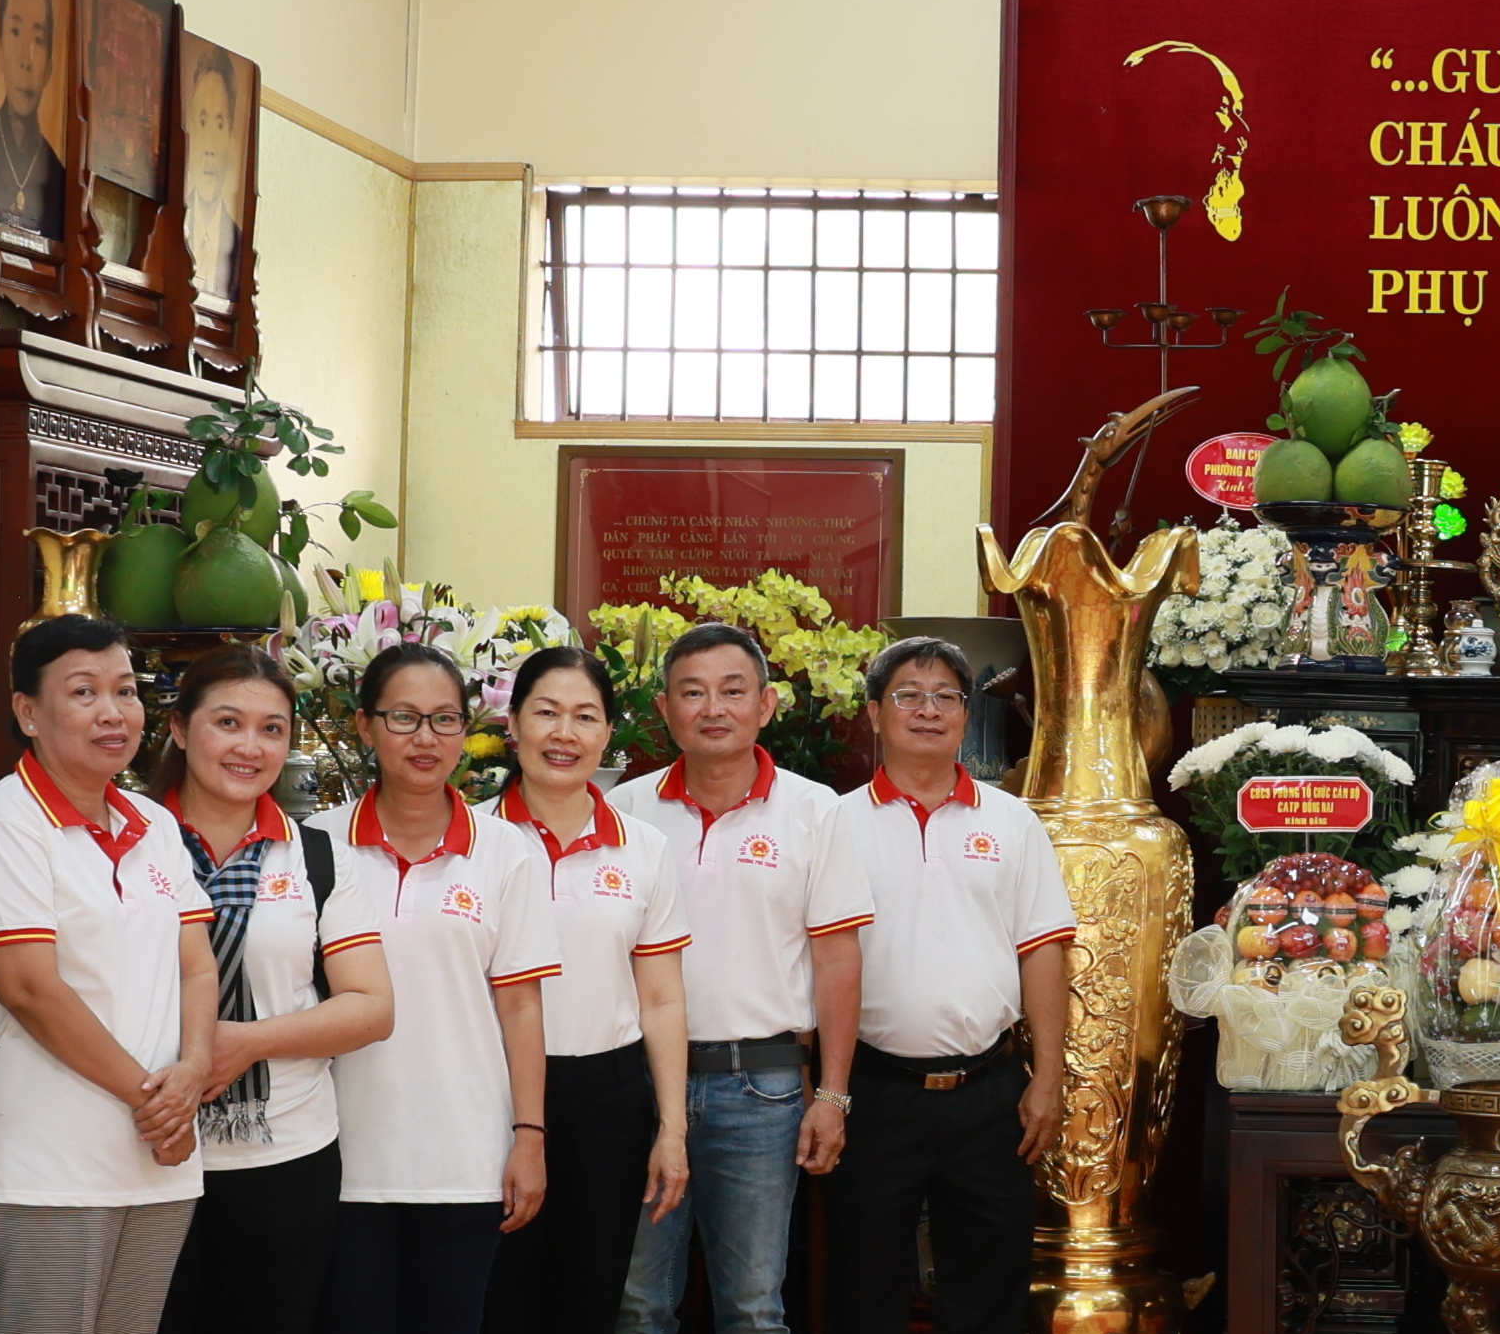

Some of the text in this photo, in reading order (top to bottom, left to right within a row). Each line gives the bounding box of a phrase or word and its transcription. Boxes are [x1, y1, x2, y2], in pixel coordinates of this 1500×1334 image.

[1367, 269, 1489, 327] PHỤ
[1225, 448, 1246, 460] BAN
[670, 516, 686, 526] TA
[756, 551, 771, 561] TA
[723, 568, 738, 577] TA
[1278, 801, 1299, 813] CATP
